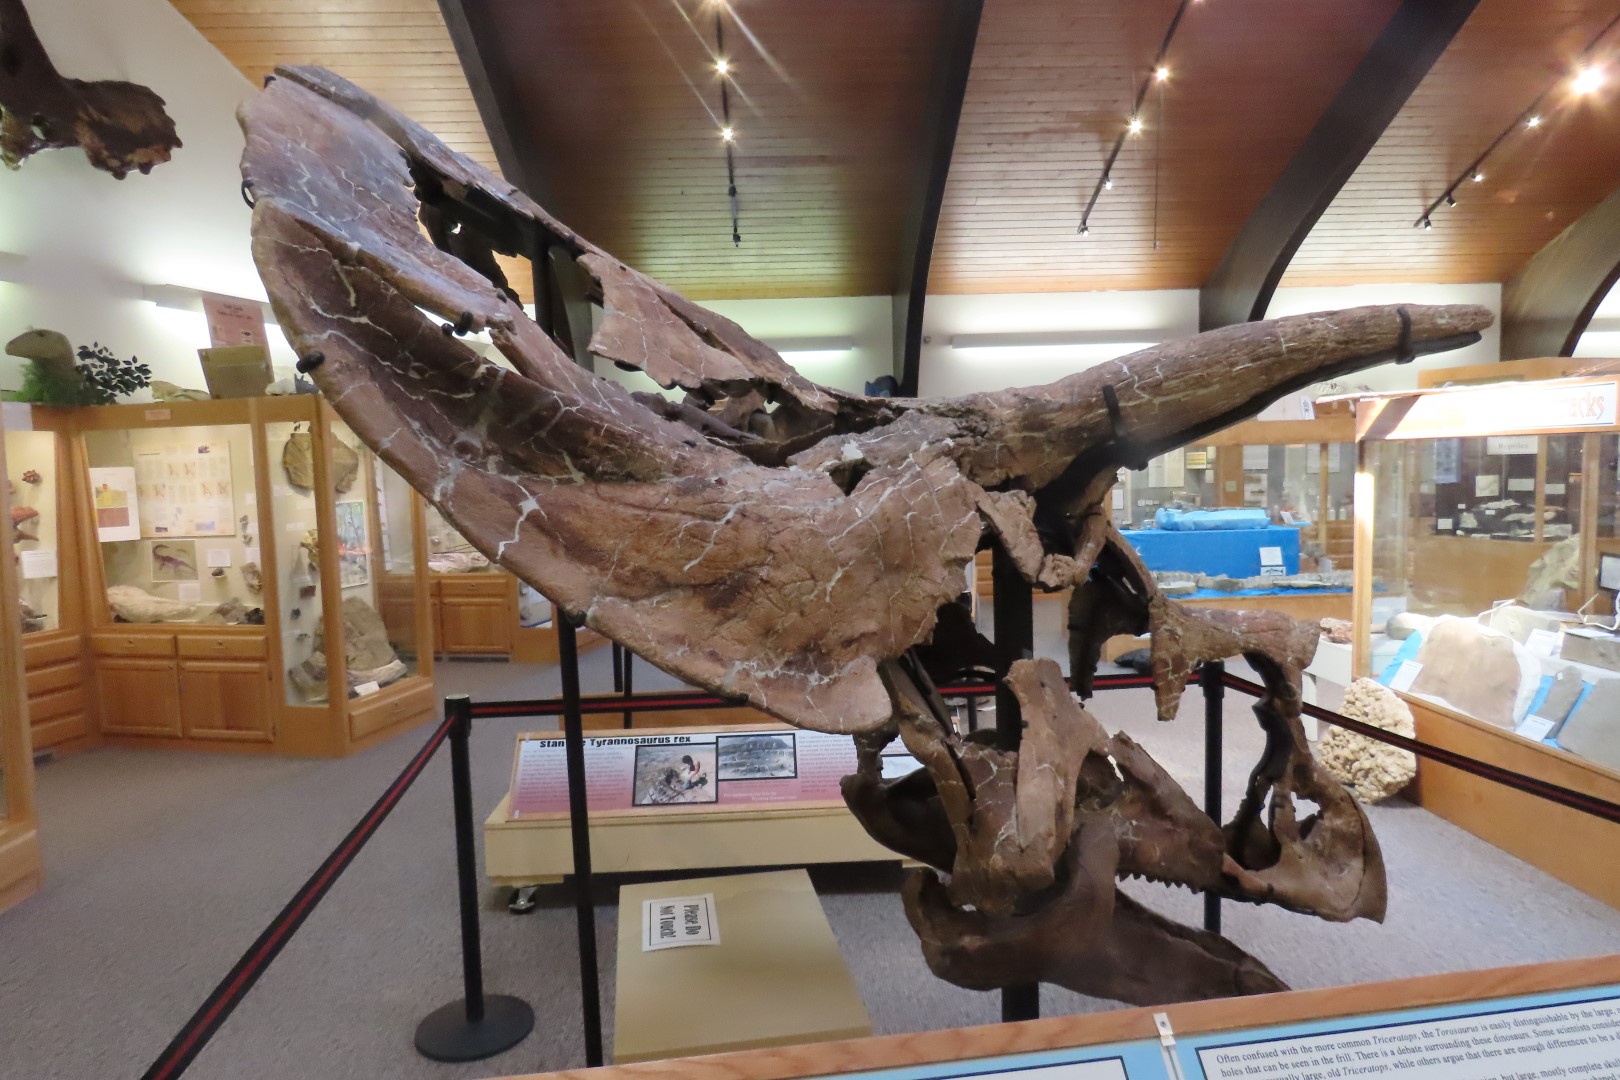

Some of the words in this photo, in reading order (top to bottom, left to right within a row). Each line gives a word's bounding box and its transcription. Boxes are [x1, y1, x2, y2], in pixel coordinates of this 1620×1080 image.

[540, 740, 565, 748] Stan
[590, 736, 671, 748] Tyrannosaurus
[673, 735, 691, 743] rex
[660, 905, 676, 916] Not
[683, 904, 699, 925] Please
[685, 925, 701, 935] Do
[1216, 1053, 1240, 1064] Often
[1242, 1048, 1279, 1060] confused
[1280, 1046, 1299, 1056] with
[1300, 1045, 1313, 1054] the
[1314, 1043, 1335, 1052] more
[1336, 1039, 1371, 1049] common
[1372, 1033, 1421, 1045] Triceratops,
[1421, 1029, 1434, 1039] the
[1435, 1026, 1479, 1037] Torosaurus
[1480, 1023, 1488, 1031] is
[1489, 1020, 1511, 1030] easily
[1513, 1012, 1569, 1027] distinguishable
[1568, 1011, 1580, 1021] by
[1580, 1010, 1593, 1018] the
[1592, 1008, 1616, 1018] large,
[1220, 1067, 1244, 1078] holes
[1245, 1065, 1261, 1075] that
[1263, 1063, 1278, 1072] can
[1278, 1061, 1290, 1070] be
[1291, 1060, 1310, 1069] seen
[1311, 1057, 1321, 1066] in
[1321, 1055, 1335, 1065] the
[1335, 1053, 1355, 1063] frill.
[1355, 1050, 1379, 1061] There
[1380, 1049, 1389, 1057] is
[1396, 1045, 1423, 1056] debate
[1424, 1039, 1472, 1052] surrounding
[1472, 1036, 1493, 1046] these
[1493, 1032, 1532, 1043] dinosaurs.
[1532, 1028, 1555, 1038] Some
[1556, 1023, 1591, 1035] scientists
[1591, 1019, 1620, 1030] conside
[1301, 1071, 1326, 1080] large,
[1327, 1067, 1341, 1078] old
[1342, 1064, 1392, 1076] Triceratops,
[1392, 1059, 1416, 1070] while
[1416, 1056, 1442, 1067] others
[1442, 1053, 1465, 1064] argue
[1465, 1051, 1482, 1060] that
[1481, 1048, 1503, 1058] there
[1503, 1047, 1516, 1055] are
[1517, 1041, 1546, 1053] enough
[1546, 1037, 1589, 1050] differences
[1588, 1036, 1598, 1044] to
[1597, 1033, 1609, 1042] be
[1539, 1066, 1567, 1077] mostly
[1567, 1062, 1603, 1074] complete
